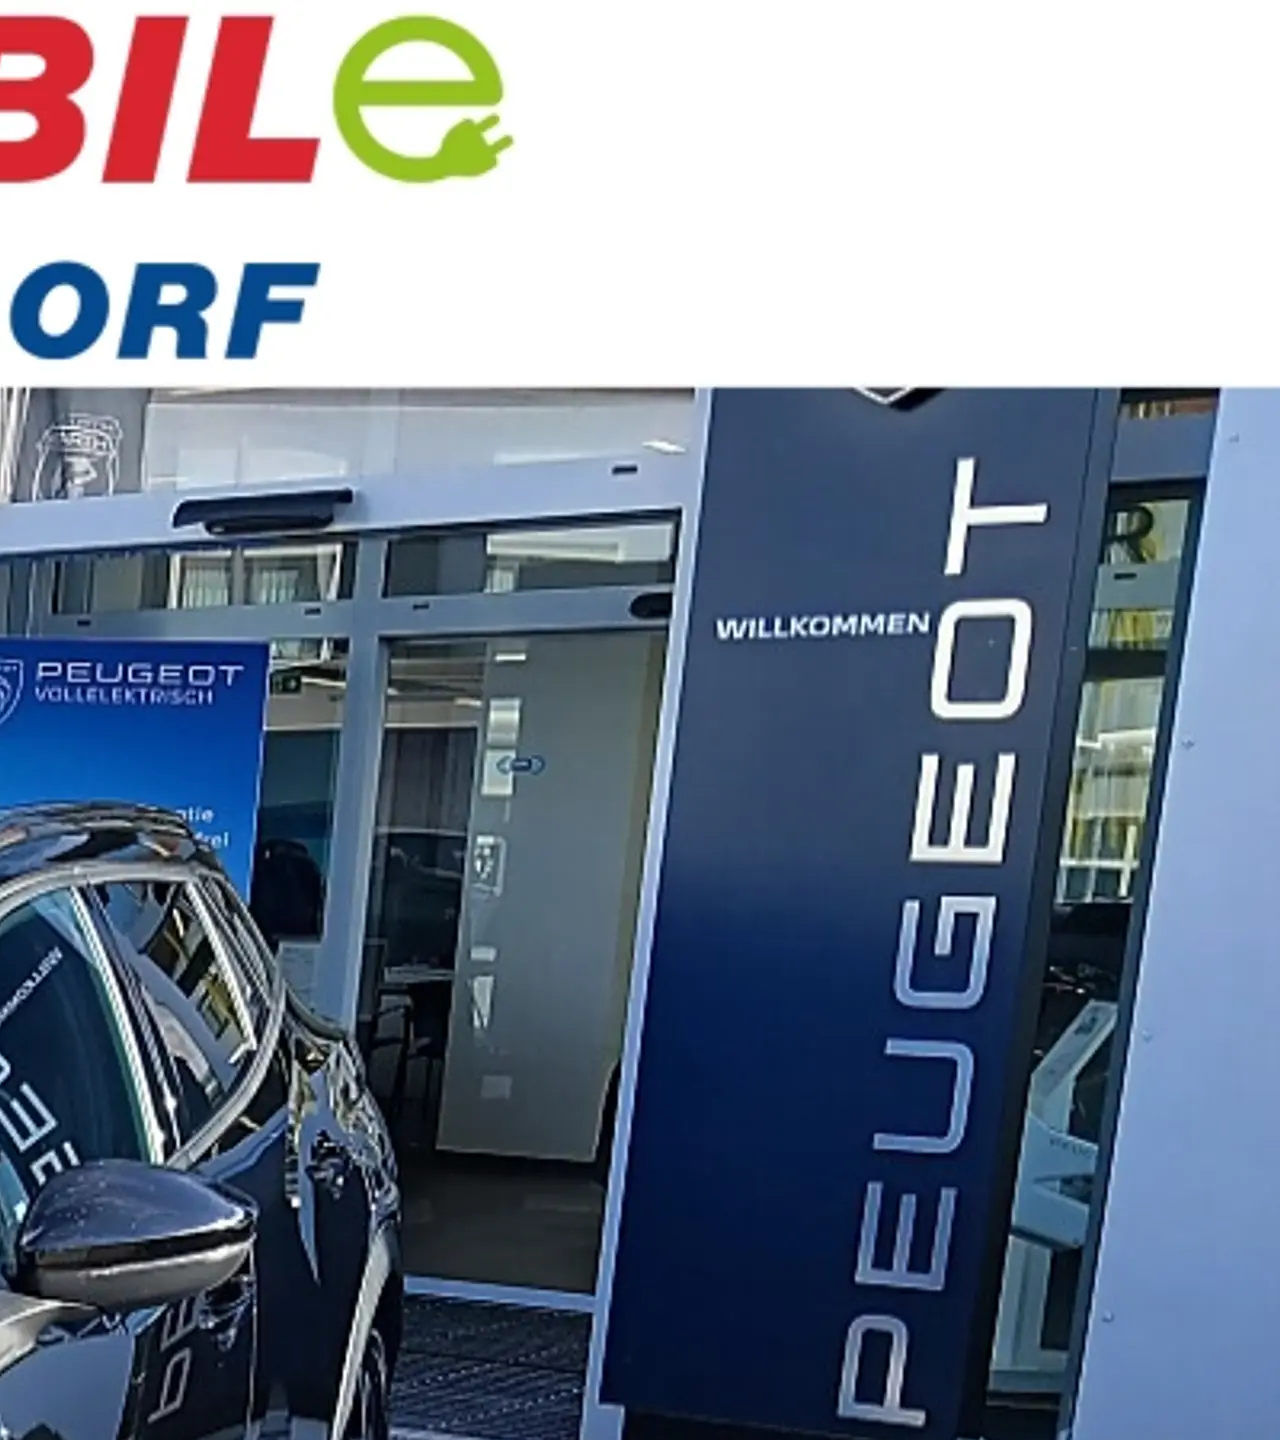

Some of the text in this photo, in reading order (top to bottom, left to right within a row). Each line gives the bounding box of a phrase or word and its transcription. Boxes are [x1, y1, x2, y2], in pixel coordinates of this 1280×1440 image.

[716, 612, 930, 640] WILLKOMMEN
[35, 661, 244, 686] PEUGEOT
[34, 685, 214, 706] VOLLELEKTRISCH
[835, 456, 1049, 1427] PEUGEOT
